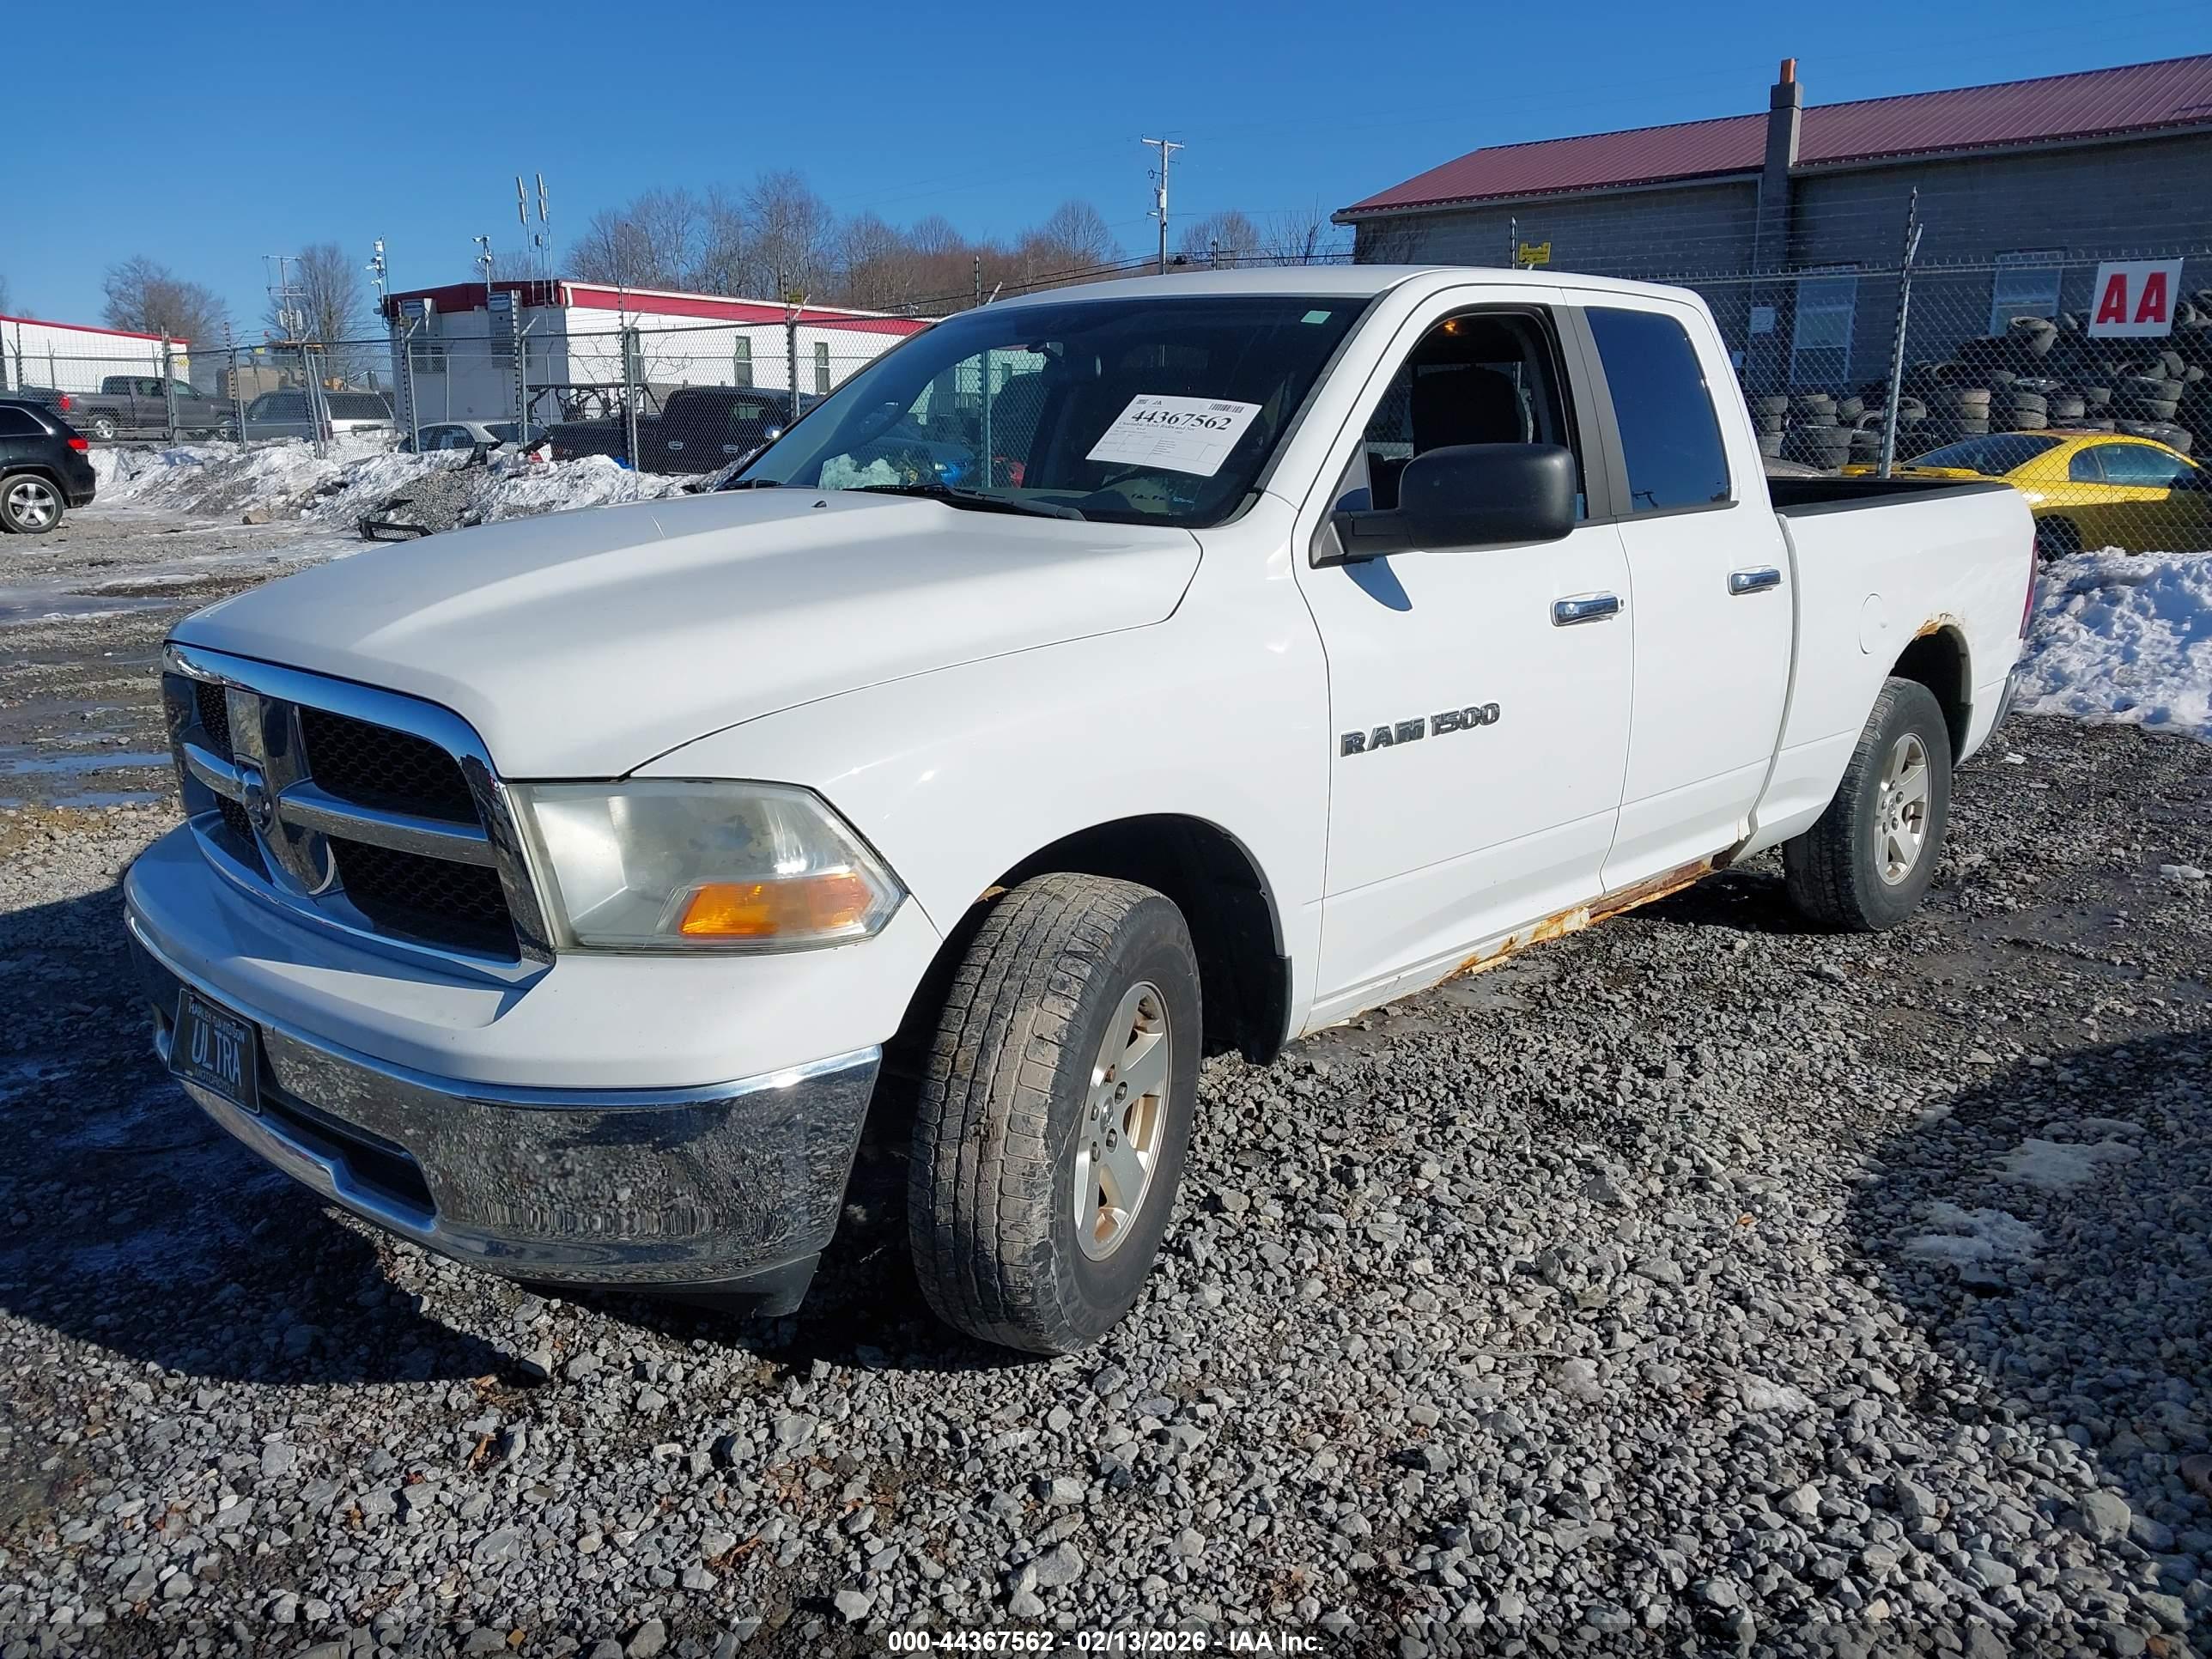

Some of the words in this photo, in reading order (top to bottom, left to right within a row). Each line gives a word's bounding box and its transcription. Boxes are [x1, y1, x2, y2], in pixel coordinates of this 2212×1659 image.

[2095, 271, 2167, 325] AA
[1131, 410, 1232, 431] 44367562
[1340, 717, 1425, 757] RAM
[1430, 702, 1501, 737] 1500
[191, 1018, 243, 1087] ULTRA
